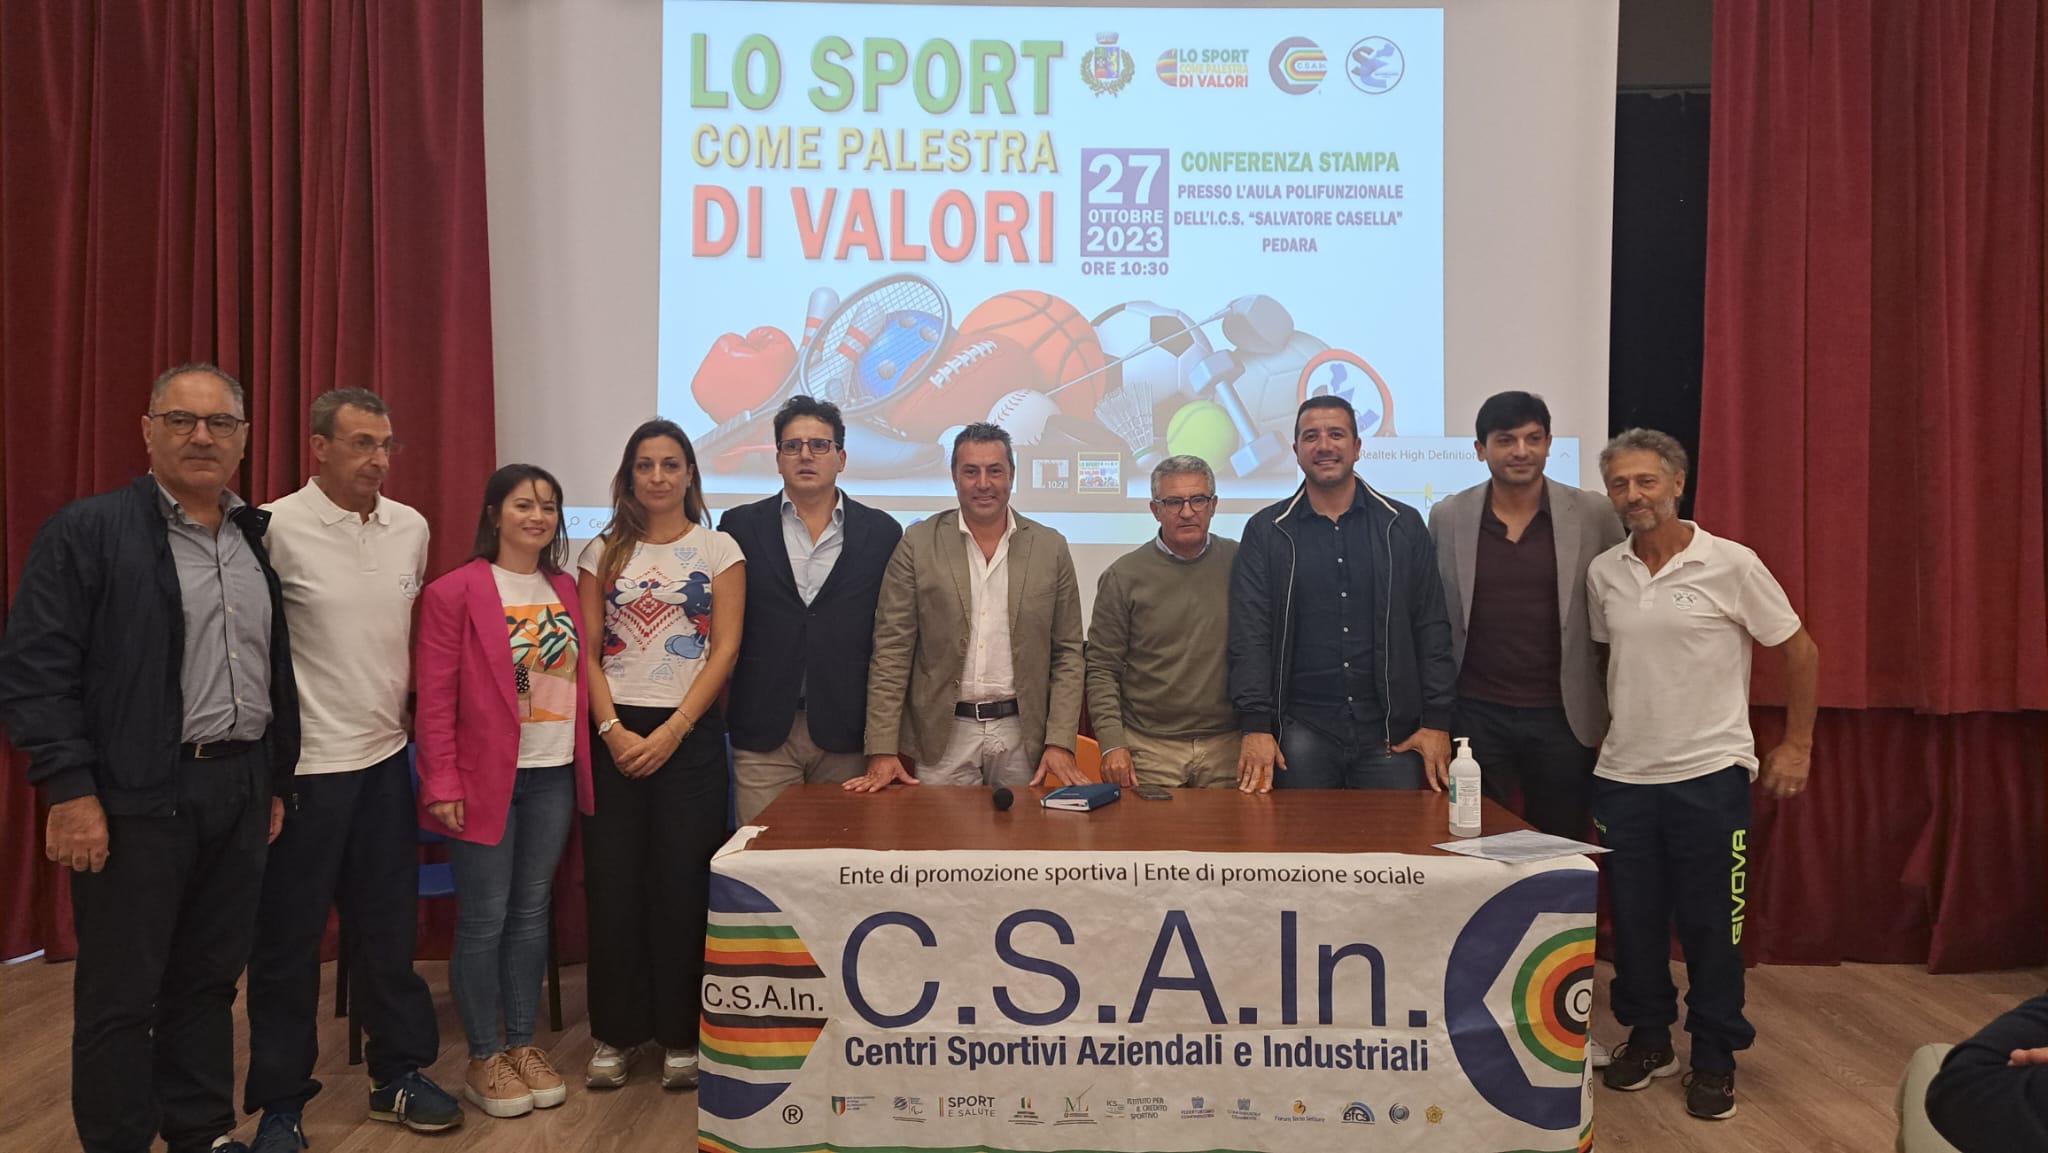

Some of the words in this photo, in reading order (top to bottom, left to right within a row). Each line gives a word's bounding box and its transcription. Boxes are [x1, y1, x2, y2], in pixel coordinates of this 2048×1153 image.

[1179, 49, 1197, 63] LO
[1201, 49, 1249, 63] SPORT
[690, 33, 782, 111] LO
[808, 36, 1064, 115] SPORT
[1179, 64, 1204, 74] COME
[1205, 64, 1249, 74] PALESTRA
[1179, 75, 1194, 87] DI
[1199, 75, 1249, 87] VALORI
[690, 122, 822, 169] COME
[837, 127, 1059, 174] PALESTRA
[1181, 151, 1313, 172] CONFERENZA
[1318, 152, 1400, 172] STAMPA
[1088, 153, 1162, 205] 27
[1177, 184, 1232, 199] PRESSO
[1236, 184, 1282, 199] L'AULA
[1286, 184, 1404, 199] POLIFUNZIONALE
[691, 184, 764, 260] DI
[790, 187, 1055, 264] VALORI
[1088, 208, 1164, 224] OTTOBRE
[1086, 226, 1164, 252] 2023
[1262, 237, 1318, 253] PEDARA
[1081, 261, 1116, 275] ORE
[1120, 261, 1169, 276] 10:30
[1400, 449, 1425, 463] High
[839, 866, 885, 885] Ente
[890, 865, 909, 884] di
[915, 863, 1039, 887] promozione
[1044, 863, 1128, 886] sportiva
[1144, 864, 1190, 881] Ente
[1195, 863, 1215, 882] di
[1221, 864, 1348, 887] promozione
[1353, 866, 1426, 885] sociale
[1731, 828, 1747, 945] GIVOVA
[845, 1036, 937, 1067] Centri
[947, 1035, 1067, 1071] Sportivi
[1076, 1033, 1223, 1067] Aziendali
[1234, 1041, 1252, 1068] e
[1263, 1035, 1429, 1072] Industriali
[947, 1095, 996, 1108] SPORT
[958, 1109, 997, 1118] SALUTE
